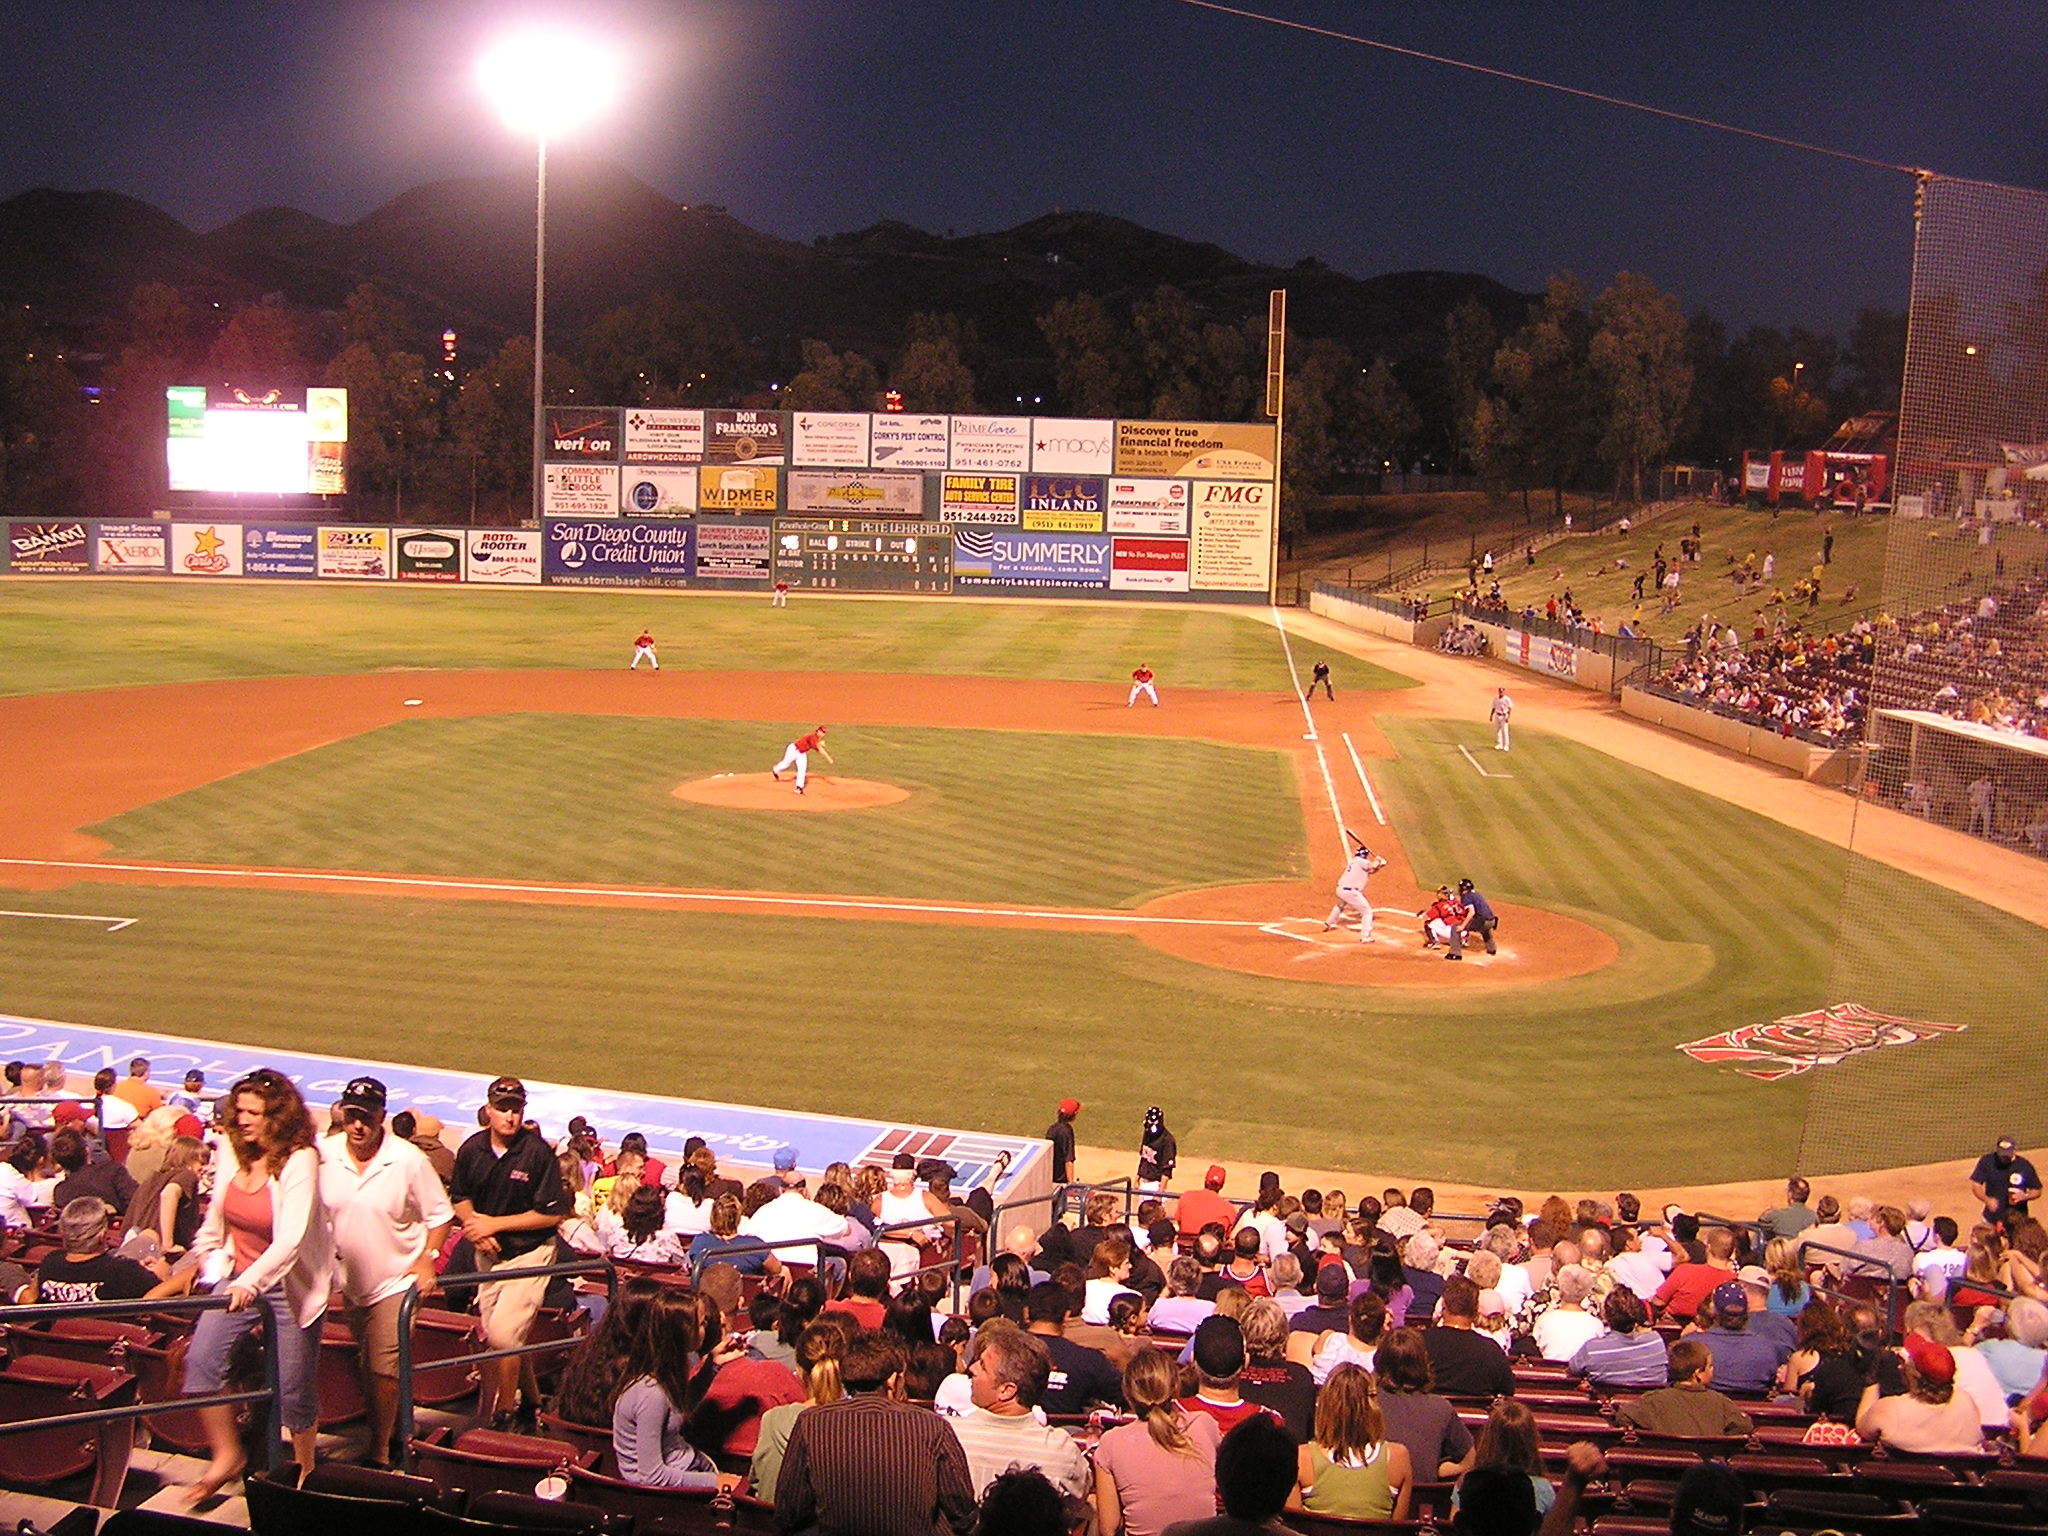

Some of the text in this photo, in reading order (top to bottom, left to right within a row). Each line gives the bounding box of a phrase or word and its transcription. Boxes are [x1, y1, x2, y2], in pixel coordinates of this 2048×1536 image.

[736, 412, 757, 422] DON
[715, 422, 778, 436] FRANCISCO'S
[1121, 426, 1199, 437] Discover true
[874, 432, 945, 441] CORKY'S PEST CONTROL
[554, 437, 611, 454] verizon
[1049, 436, 1110, 457] macy's
[1120, 437, 1223, 449] financial freedom
[316, 458, 342, 466] BUD
[954, 459, 1022, 467] 951-461-0762
[561, 467, 615, 475] COMMUNITY
[568, 475, 601, 483] LITTLE
[946, 477, 1014, 490] FAMILY TIRE
[574, 484, 603, 492] BOOK
[1029, 478, 1098, 499] LGC
[703, 488, 775, 502] WIDMER
[944, 490, 1015, 503] AUTO SERVICE CENTER
[1204, 486, 1263, 504] FMG
[554, 502, 609, 510] 951-695-1928
[1031, 499, 1098, 511] INLAND
[943, 512, 1016, 522] 951-244-9229
[101, 524, 162, 533] Image Source
[860, 522, 951, 535] PETE LEHR FIELD
[11, 524, 86, 551] BAMM!
[482, 533, 518, 542] ROTO-
[551, 523, 688, 548] San Diego County
[480, 541, 528, 551] ROOTER
[698, 541, 717, 549] Lunch
[719, 542, 745, 550] Specials
[809, 539, 904, 549] BALL STRIKE OUT
[123, 545, 162, 558] XEROX
[591, 543, 638, 563] Credit
[640, 544, 686, 564] Union
[993, 541, 1110, 564] SUMMERLY
[1146, 551, 1171, 560] Mortgage
[777, 560, 804, 568] VISITOR
[650, 566, 686, 574] sdccu.com
[551, 575, 688, 587] www.stormbaseball.com
[960, 577, 1104, 588] SummerlyLakeElsinore.com
